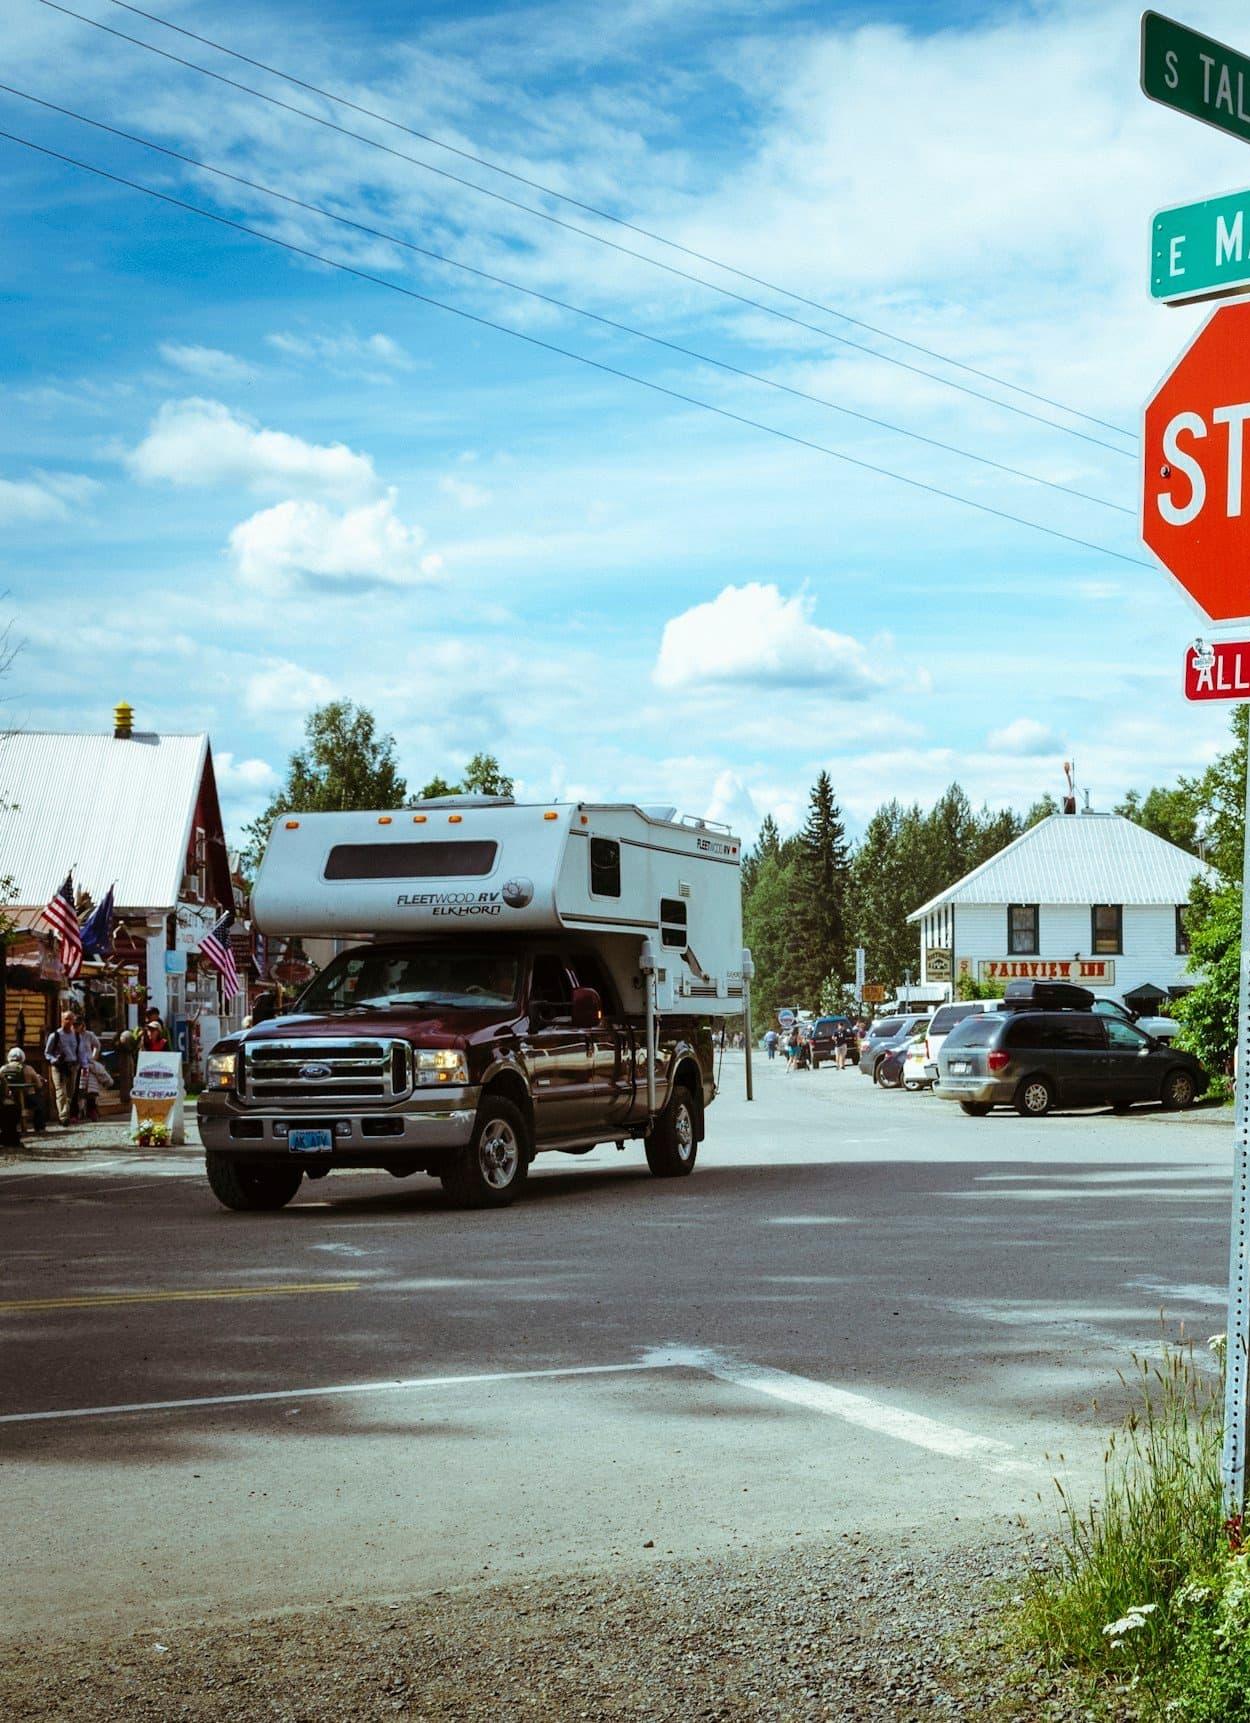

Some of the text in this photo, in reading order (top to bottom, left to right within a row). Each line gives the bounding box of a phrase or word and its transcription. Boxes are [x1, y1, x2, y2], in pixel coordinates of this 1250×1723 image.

[1164, 51, 1179, 88] S
[1169, 235, 1186, 277] E
[1195, 654, 1250, 691] ALL
[397, 892, 500, 905] FLEETWOOD RV
[432, 905, 501, 917] ELKHORN
[989, 962, 1106, 977] FAIRVIEW INN
